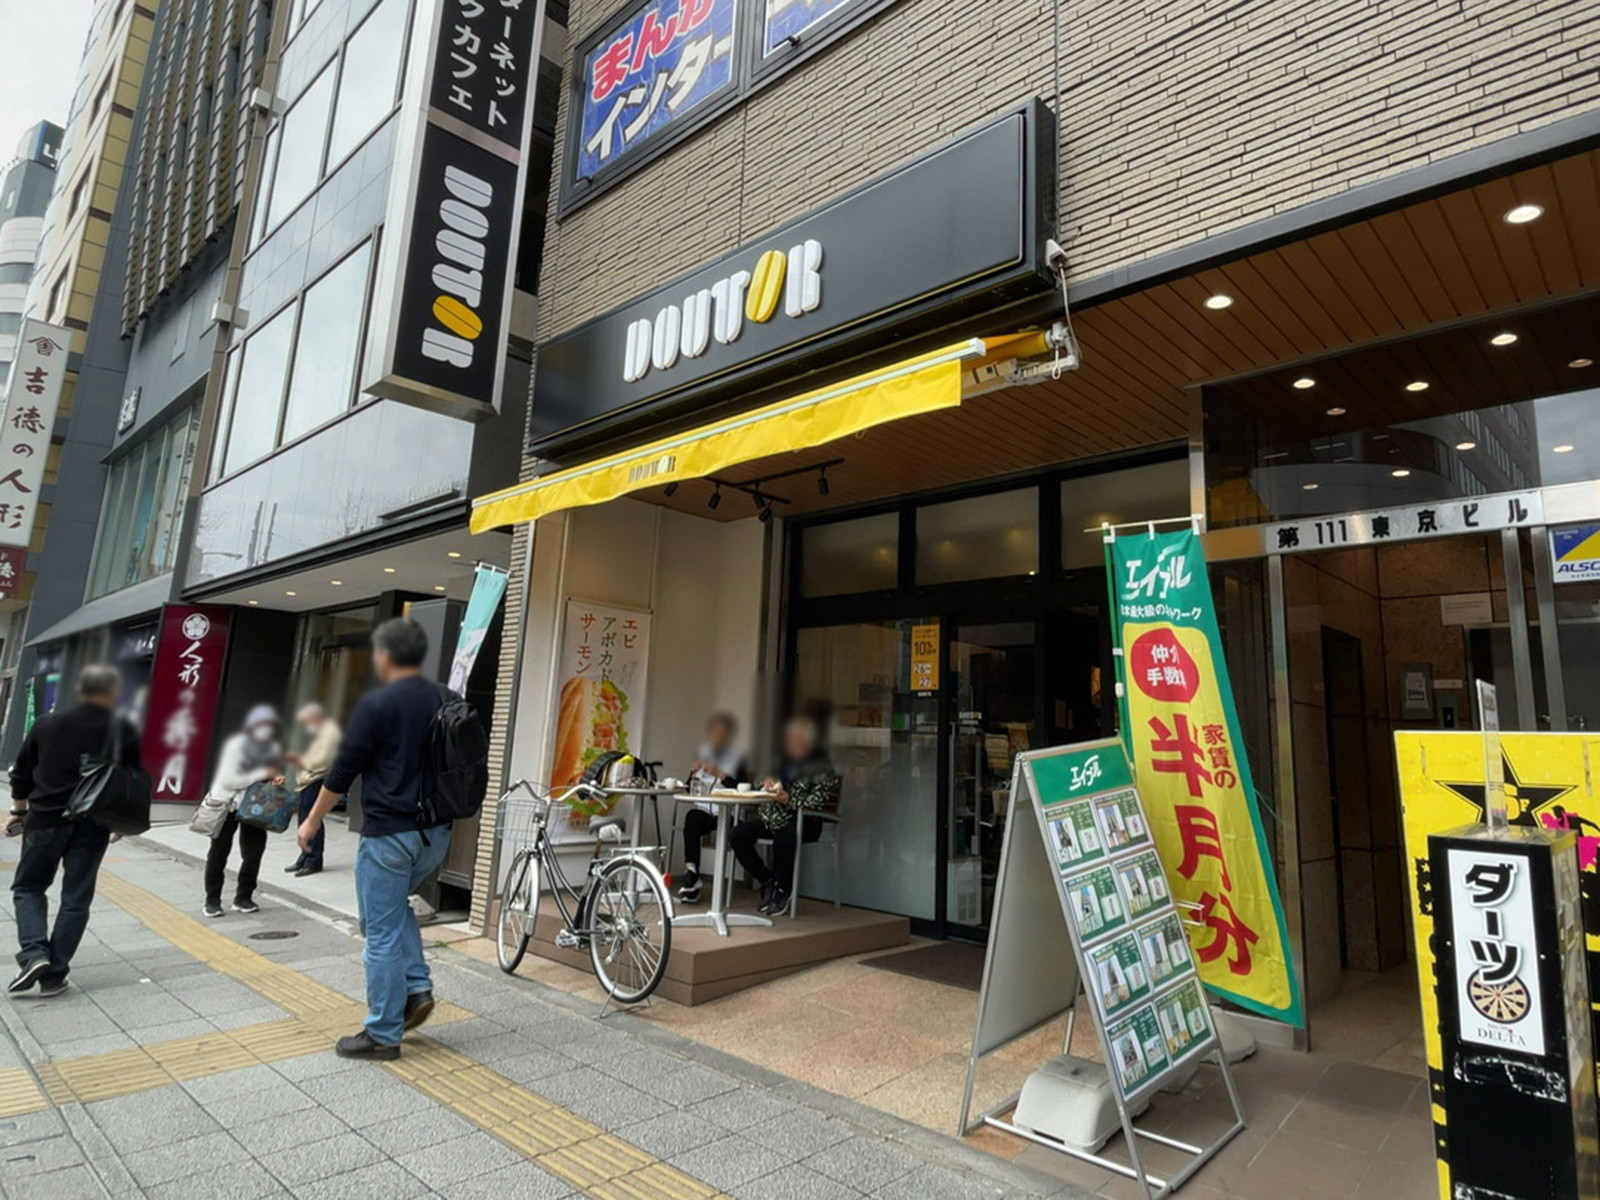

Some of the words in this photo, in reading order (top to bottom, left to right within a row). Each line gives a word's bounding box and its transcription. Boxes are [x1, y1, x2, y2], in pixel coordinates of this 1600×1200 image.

[421, 164, 493, 368] DOUTOR
[623, 239, 822, 383] DOUTOR
[0, 365, 48, 529] 吉徳の人形
[576, 612, 596, 674] サーモン
[598, 616, 617, 686] アボカド
[622, 619, 638, 649] エビ
[1201, 723, 1237, 789] 家賃の
[1148, 713, 1260, 977] 半月分
[1464, 862, 1519, 983] ダーツ
[1477, 1027, 1526, 1046] DELTA
